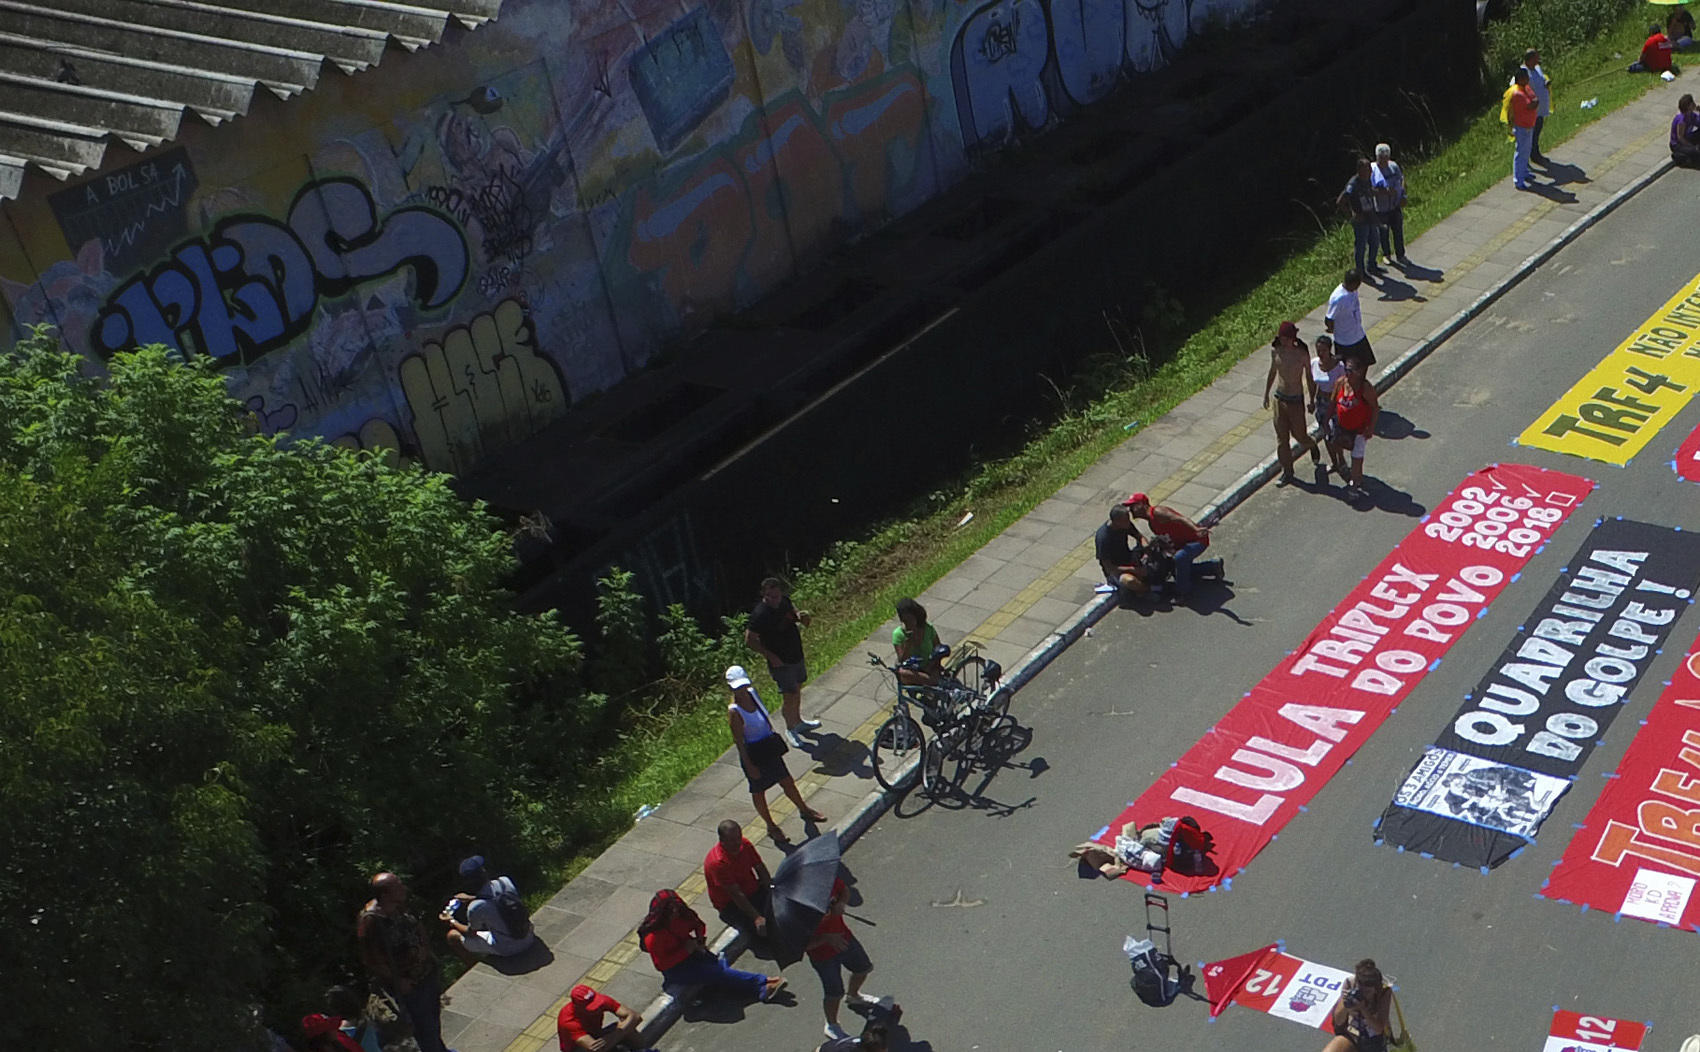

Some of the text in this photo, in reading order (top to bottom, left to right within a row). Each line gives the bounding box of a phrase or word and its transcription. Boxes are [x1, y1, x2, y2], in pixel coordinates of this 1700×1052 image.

[1624, 326, 1689, 361] NÃO
[1494, 507, 1563, 558] 2018
[1289, 486, 1498, 678] TRIPLEX 2002
[1351, 495, 1534, 696] DO POVO 2006
[1454, 550, 1651, 746] QUADRILHA
[1525, 713, 1599, 762] DO
[1168, 700, 1368, 826] LULA
[1397, 788, 1413, 803] OS
[1411, 748, 1445, 784] AMIGOS
[1626, 882, 1649, 905] MORO
[1644, 889, 1663, 905] KD
[1245, 968, 1283, 996] 12
[1299, 972, 1342, 991] PDT
[1575, 1016, 1617, 1040] 12
